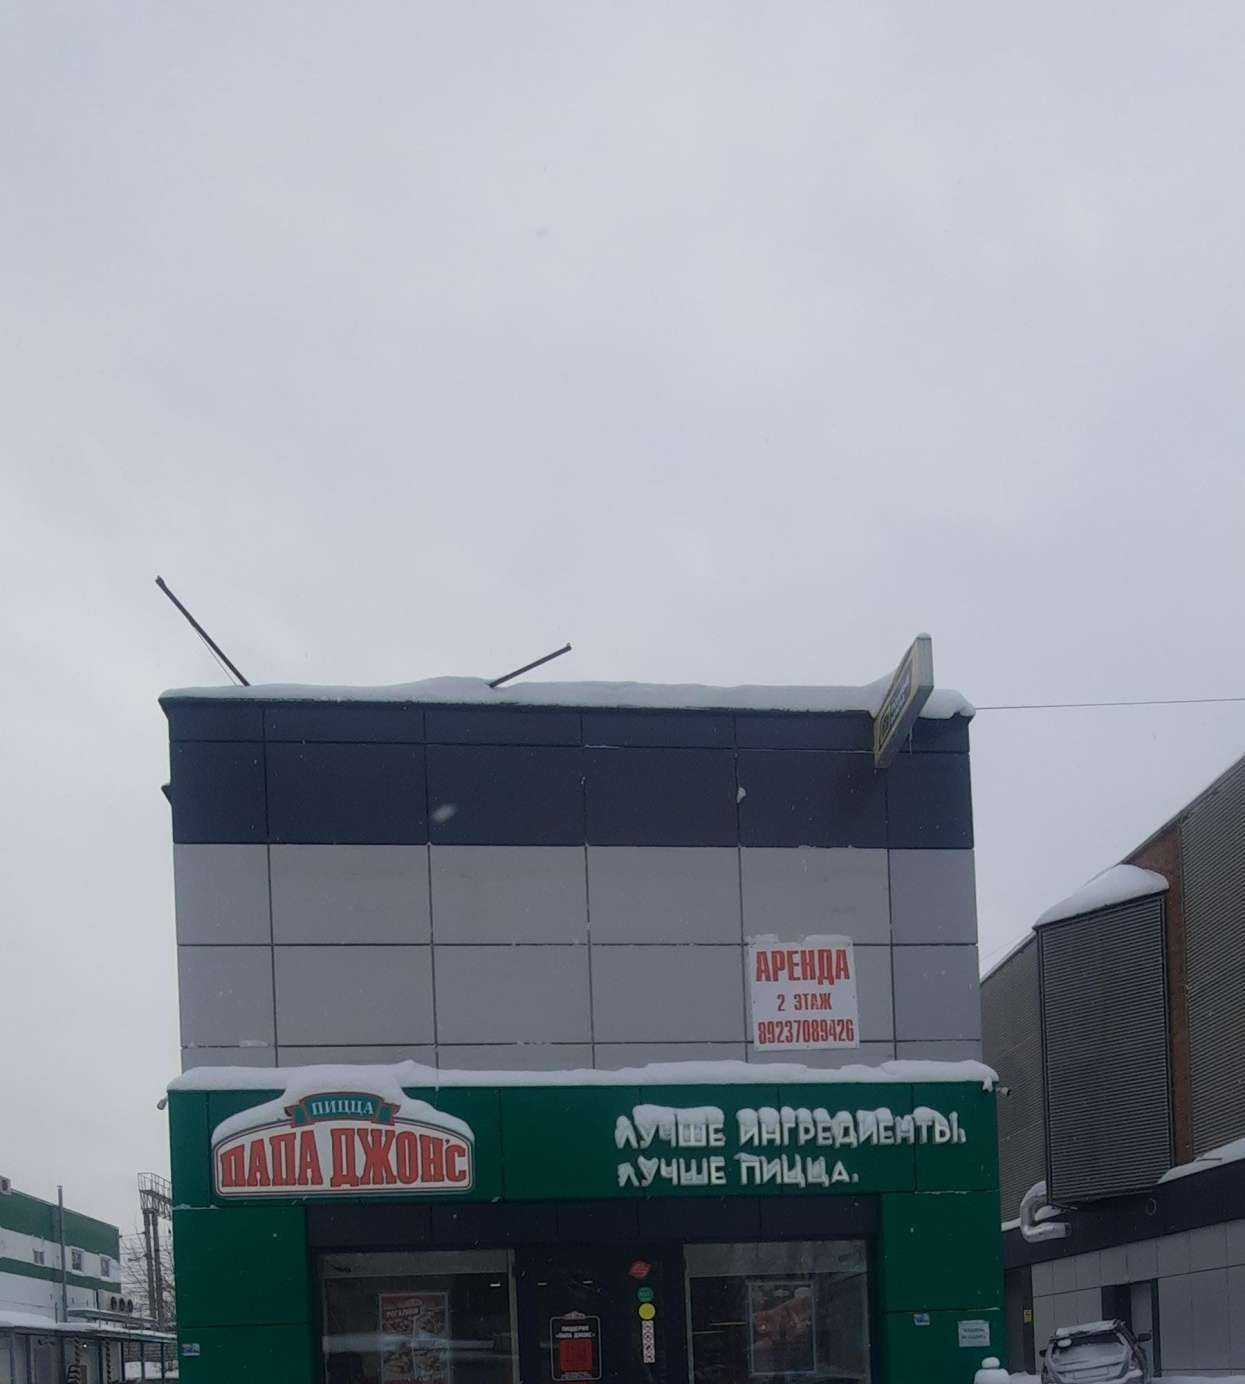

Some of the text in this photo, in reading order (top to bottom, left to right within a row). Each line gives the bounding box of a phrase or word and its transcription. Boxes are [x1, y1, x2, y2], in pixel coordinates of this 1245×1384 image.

[756, 948, 850, 986] АРЕНДА
[776, 992, 832, 1012] 2 ЭТАЖ
[757, 1018, 855, 1045] 89237089426
[311, 1099, 375, 1117] ПИЦЦА
[614, 1108, 727, 1149] ЛУЧШЕ
[219, 1130, 324, 1188] ПАПА
[616, 1154, 859, 1188] ЛУЧШЕ ПИЦЦА.
